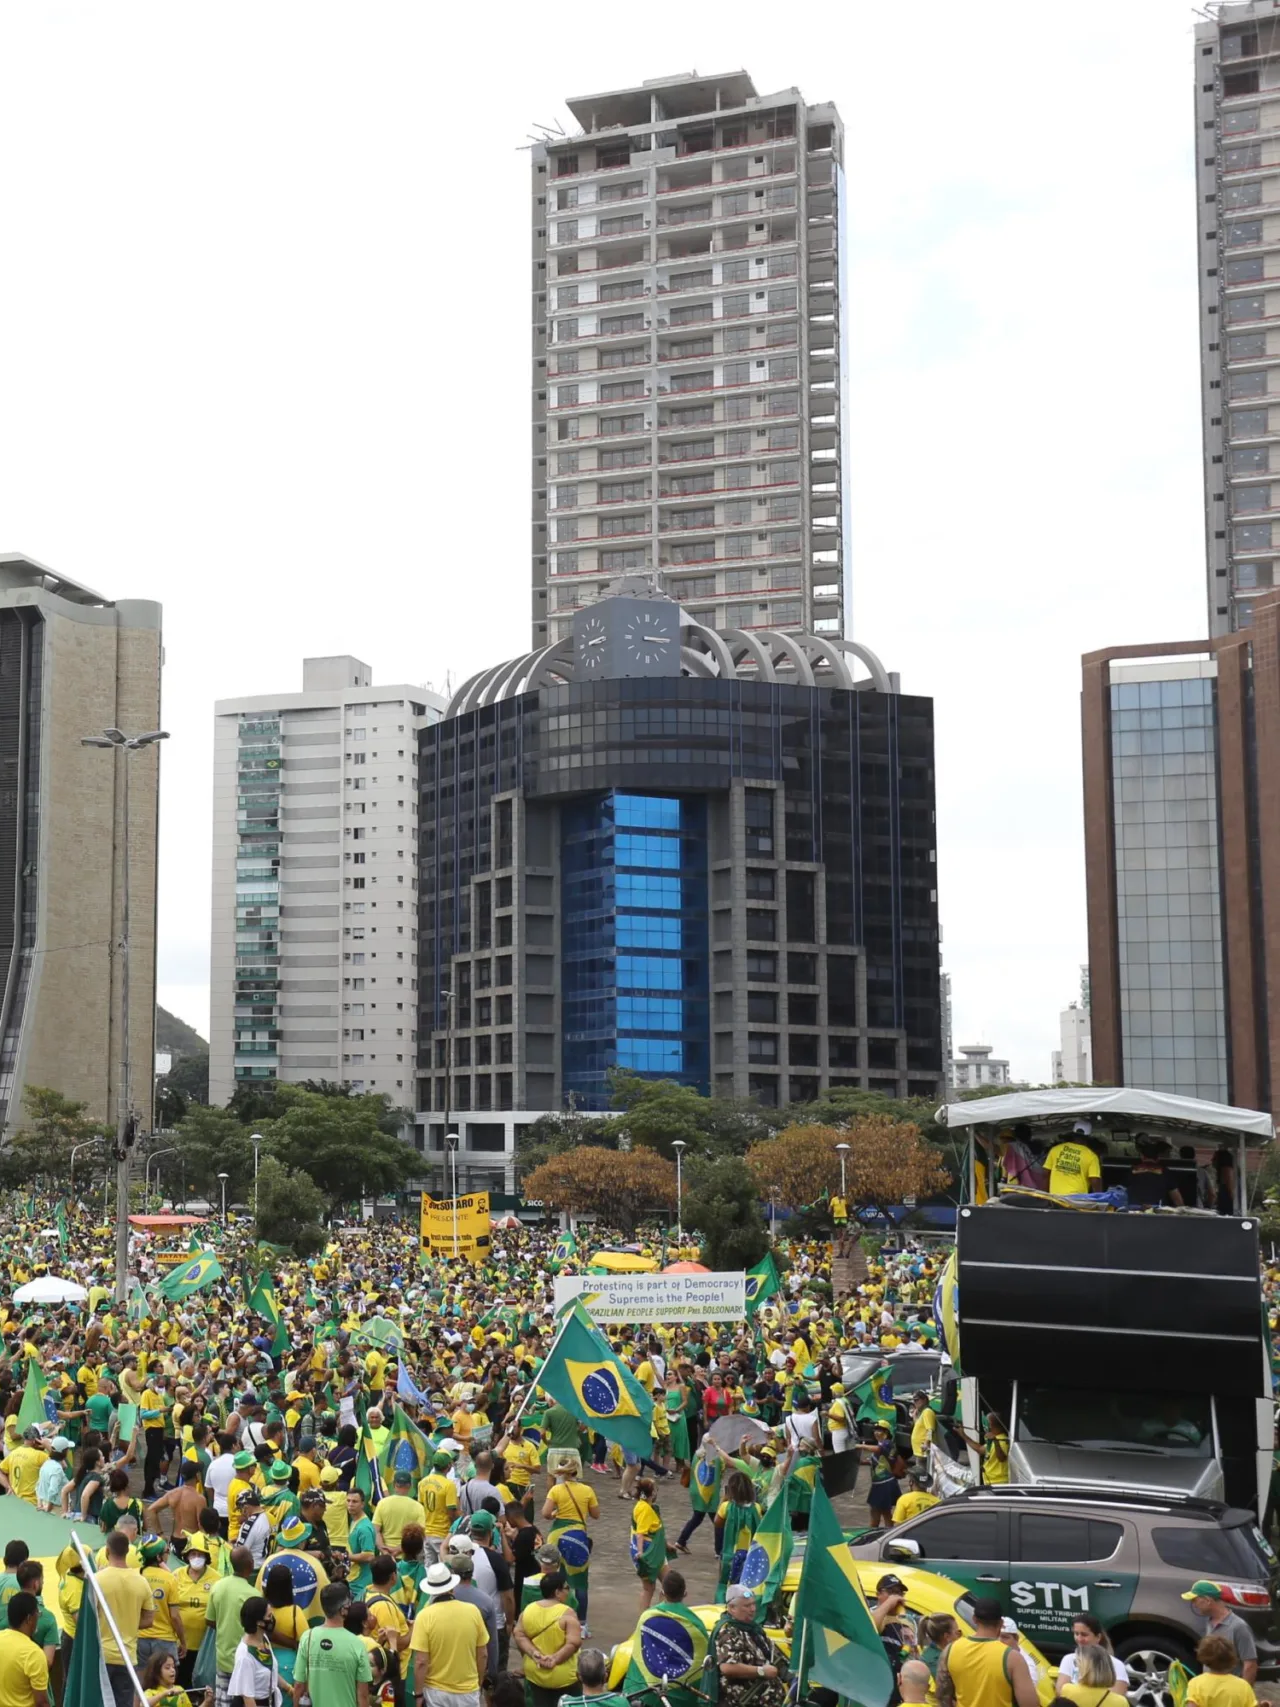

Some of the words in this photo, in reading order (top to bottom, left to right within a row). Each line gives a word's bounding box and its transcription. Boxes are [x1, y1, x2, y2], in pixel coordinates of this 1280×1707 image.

[429, 1198, 474, 1211] BOLSONARO
[582, 1280, 632, 1292] Protesting
[636, 1281, 644, 1290] is
[647, 1280, 667, 1291] part
[671, 1281, 680, 1291] of
[684, 1278, 744, 1290] Democracy!
[609, 1293, 656, 1304] Supreme
[657, 1292, 664, 1303] is
[666, 1293, 683, 1303] the
[685, 1292, 724, 1303] People!
[626, 1307, 653, 1316] PEOPLE
[655, 1306, 686, 1316] SUPPORT
[702, 1305, 743, 1315] BOLSONARO
[1010, 1580, 1090, 1611] STM
[189, 1596, 200, 1608] 10
[1016, 1607, 1053, 1616] SUPERIOR
[1039, 1615, 1068, 1623] MILITAR
[1017, 1621, 1036, 1629] Fora
[1037, 1623, 1070, 1632] ditadura
